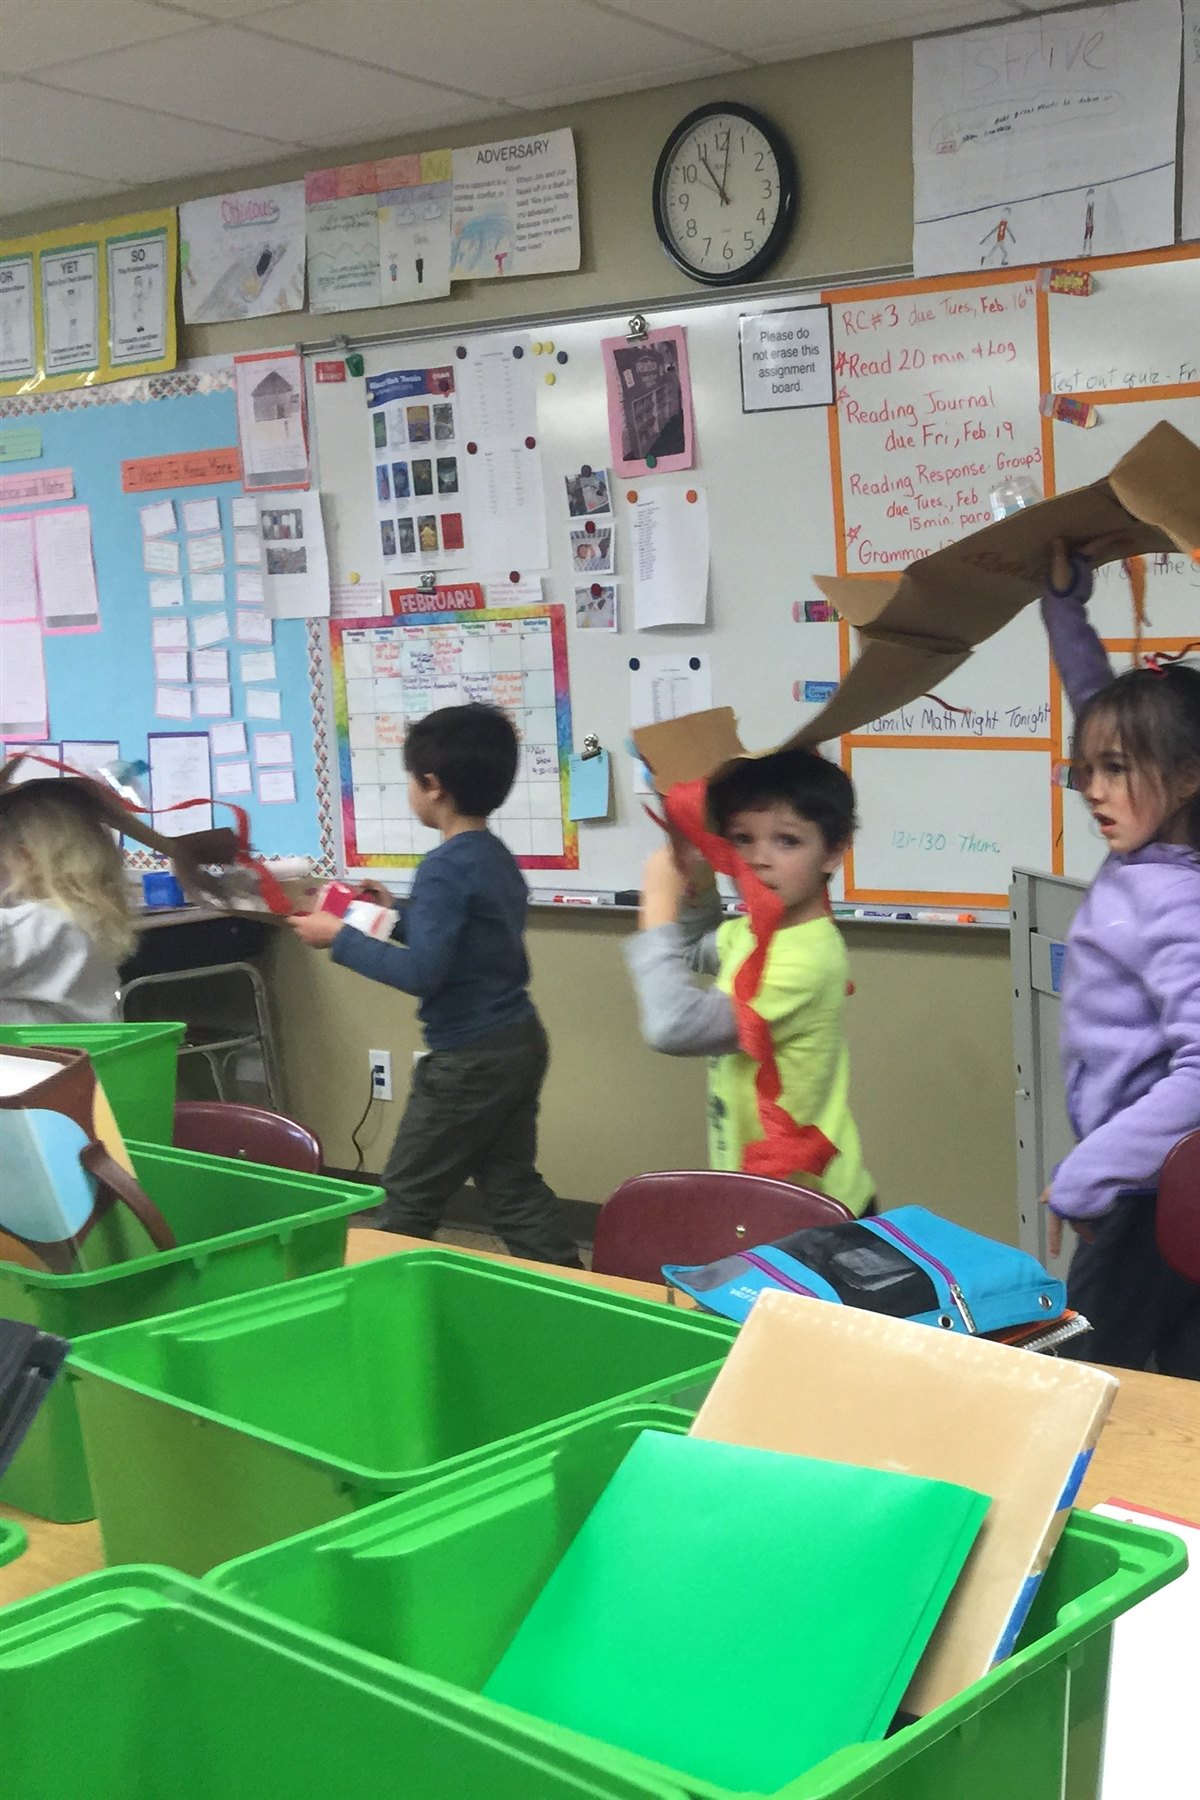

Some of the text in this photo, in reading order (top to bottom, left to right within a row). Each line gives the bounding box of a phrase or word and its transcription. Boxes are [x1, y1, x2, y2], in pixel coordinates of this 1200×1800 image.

[477, 140, 550, 164] ADVERSARY
[754, 152, 764, 172] 2
[682, 164, 698, 184] 10
[762, 180, 772, 199] 3
[679, 194, 689, 212] 9
[756, 208, 766, 226] 4
[686, 218, 697, 238] 8
[702, 238, 712, 256] 7
[722, 241, 733, 259] 6
[744, 231, 754, 250] 5
[132, 249, 146, 262] SO
[60, 260, 78, 274] YET
[909, 303, 936, 326] due
[760, 328, 810, 342] Please do
[753, 344, 820, 360] not erase this
[850, 351, 892, 378] Read
[898, 348, 924, 370] 20
[988, 340, 1016, 363] Log
[758, 362, 816, 378] assignment
[772, 381, 804, 394] board.
[1050, 368, 1082, 392] Test
[1087, 368, 1118, 389] out
[846, 386, 996, 427] Reading Journal
[886, 429, 916, 451] due
[996, 422, 1014, 440] 19
[850, 473, 914, 497] Reading
[887, 502, 908, 518] due
[400, 590, 476, 612] FEBRUARY
[921, 708, 956, 730] Math
[960, 710, 999, 736] Night
[1005, 703, 1051, 732] Tonight
